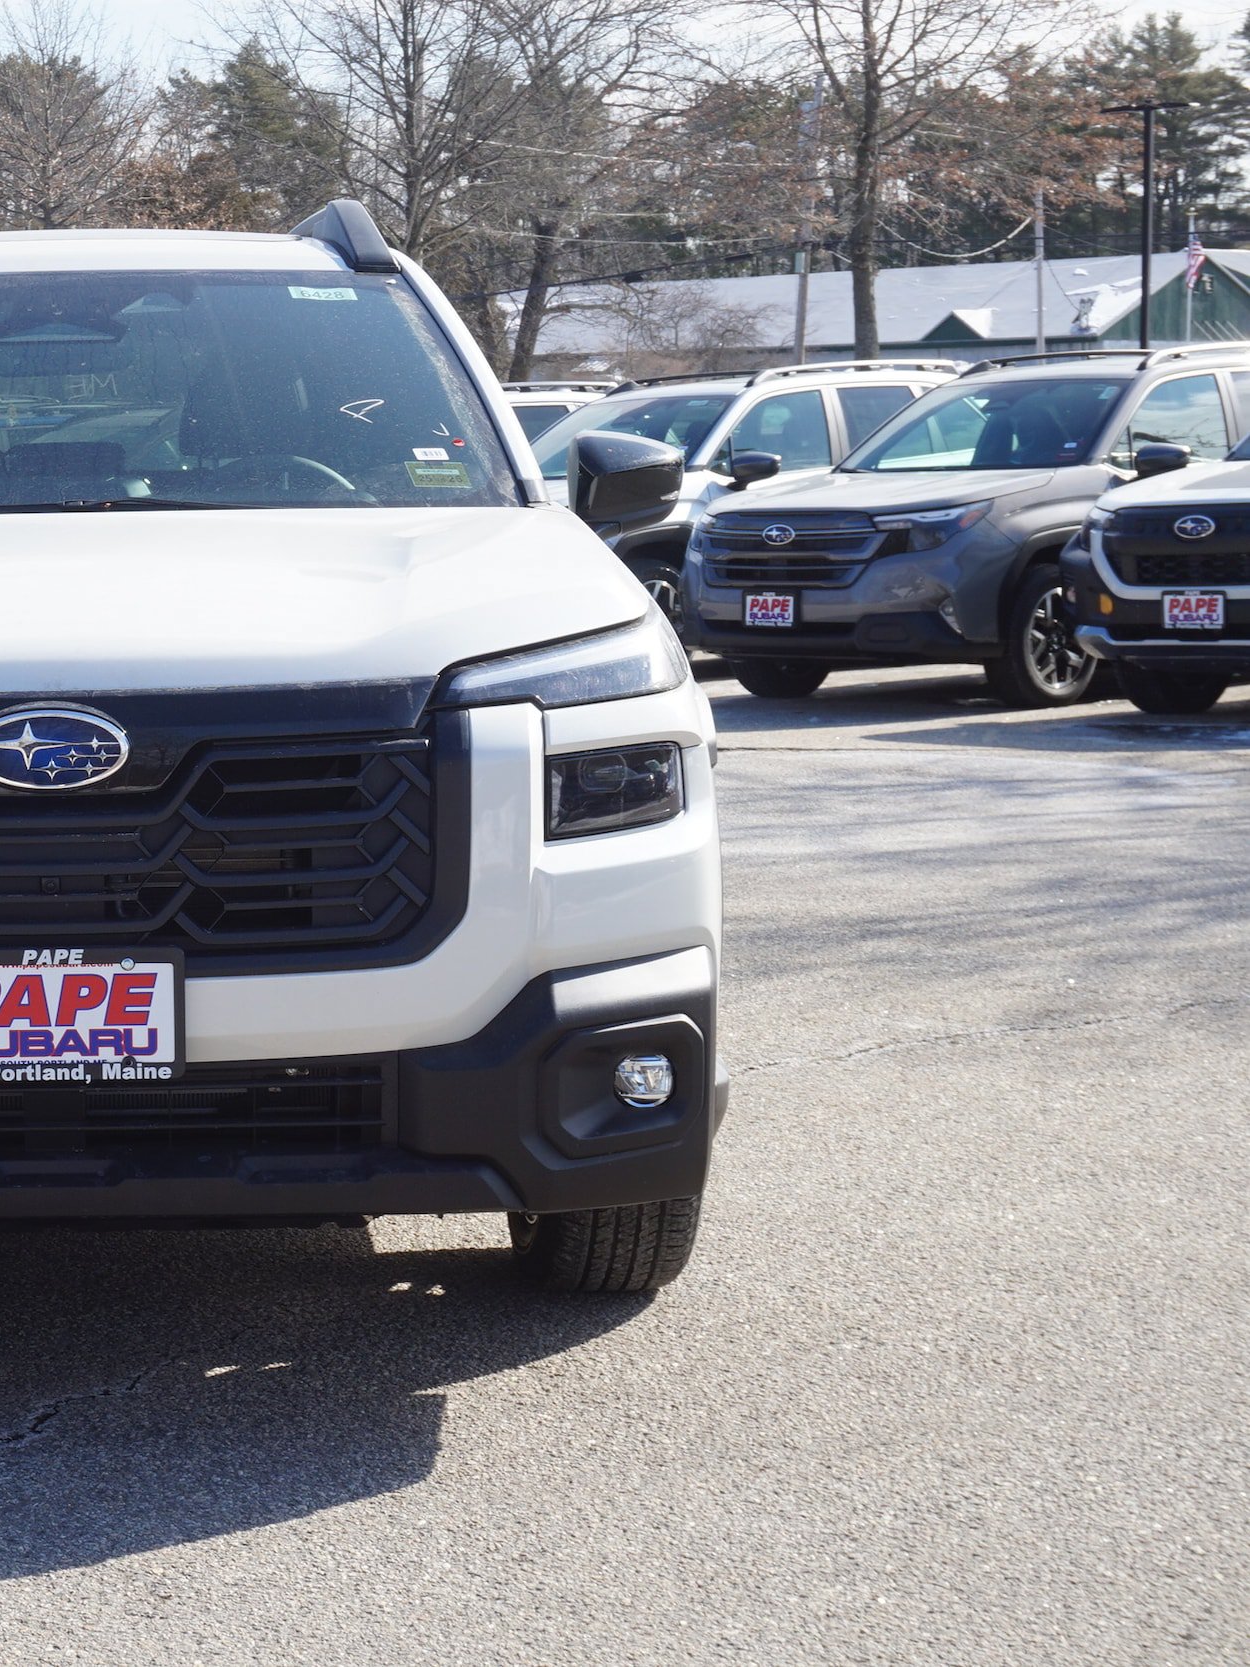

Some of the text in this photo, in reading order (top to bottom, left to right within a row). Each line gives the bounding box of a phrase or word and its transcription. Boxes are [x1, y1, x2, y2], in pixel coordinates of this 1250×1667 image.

[300, 290, 344, 299] 6428
[750, 598, 790, 612] PAPE
[1168, 598, 1219, 613] PAPE
[749, 612, 790, 620] SUBARU
[21, 949, 85, 965] PAPE
[102, 1061, 173, 1081] Maine
